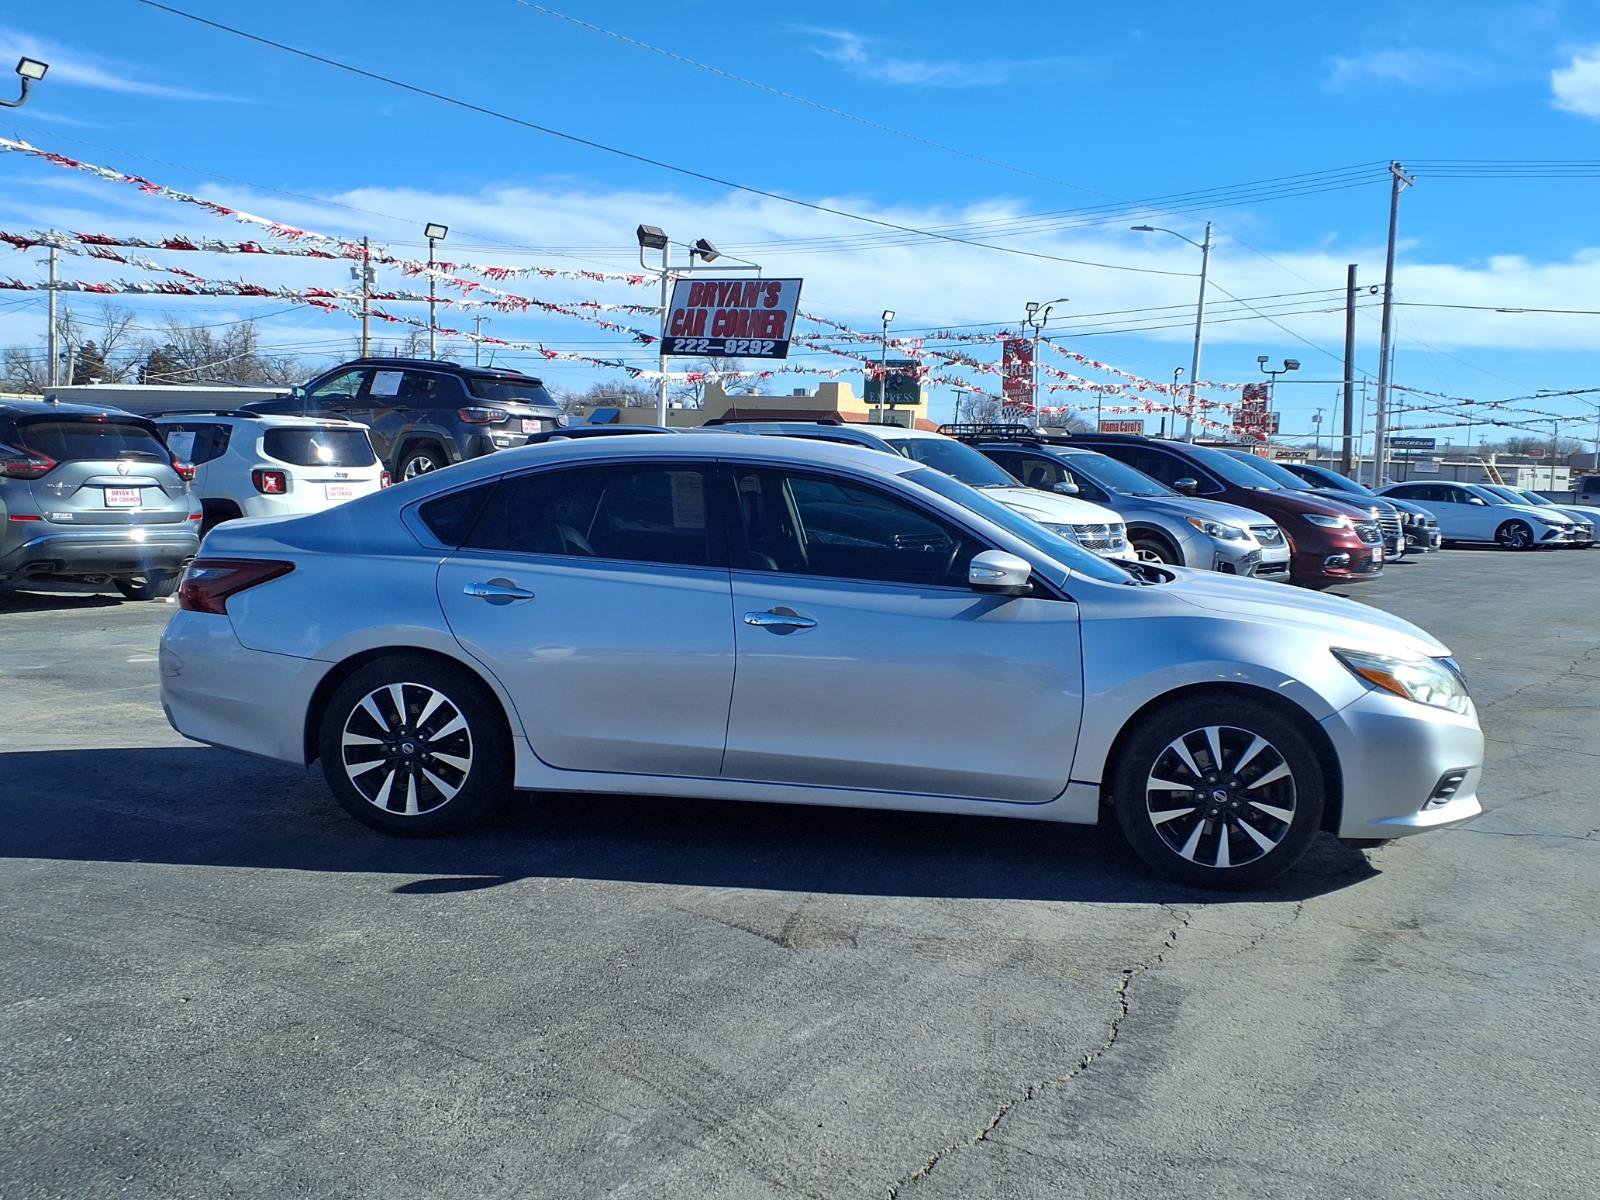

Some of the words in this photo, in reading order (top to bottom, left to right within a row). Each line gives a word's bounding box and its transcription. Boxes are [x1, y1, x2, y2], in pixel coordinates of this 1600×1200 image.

[687, 281, 782, 309] BRYAN'S
[669, 308, 709, 338] CAR
[711, 308, 788, 340] CORNER
[672, 338, 776, 355] 222-9292
[1101, 421, 1119, 432] Mama
[1120, 421, 1142, 432] Carol's
